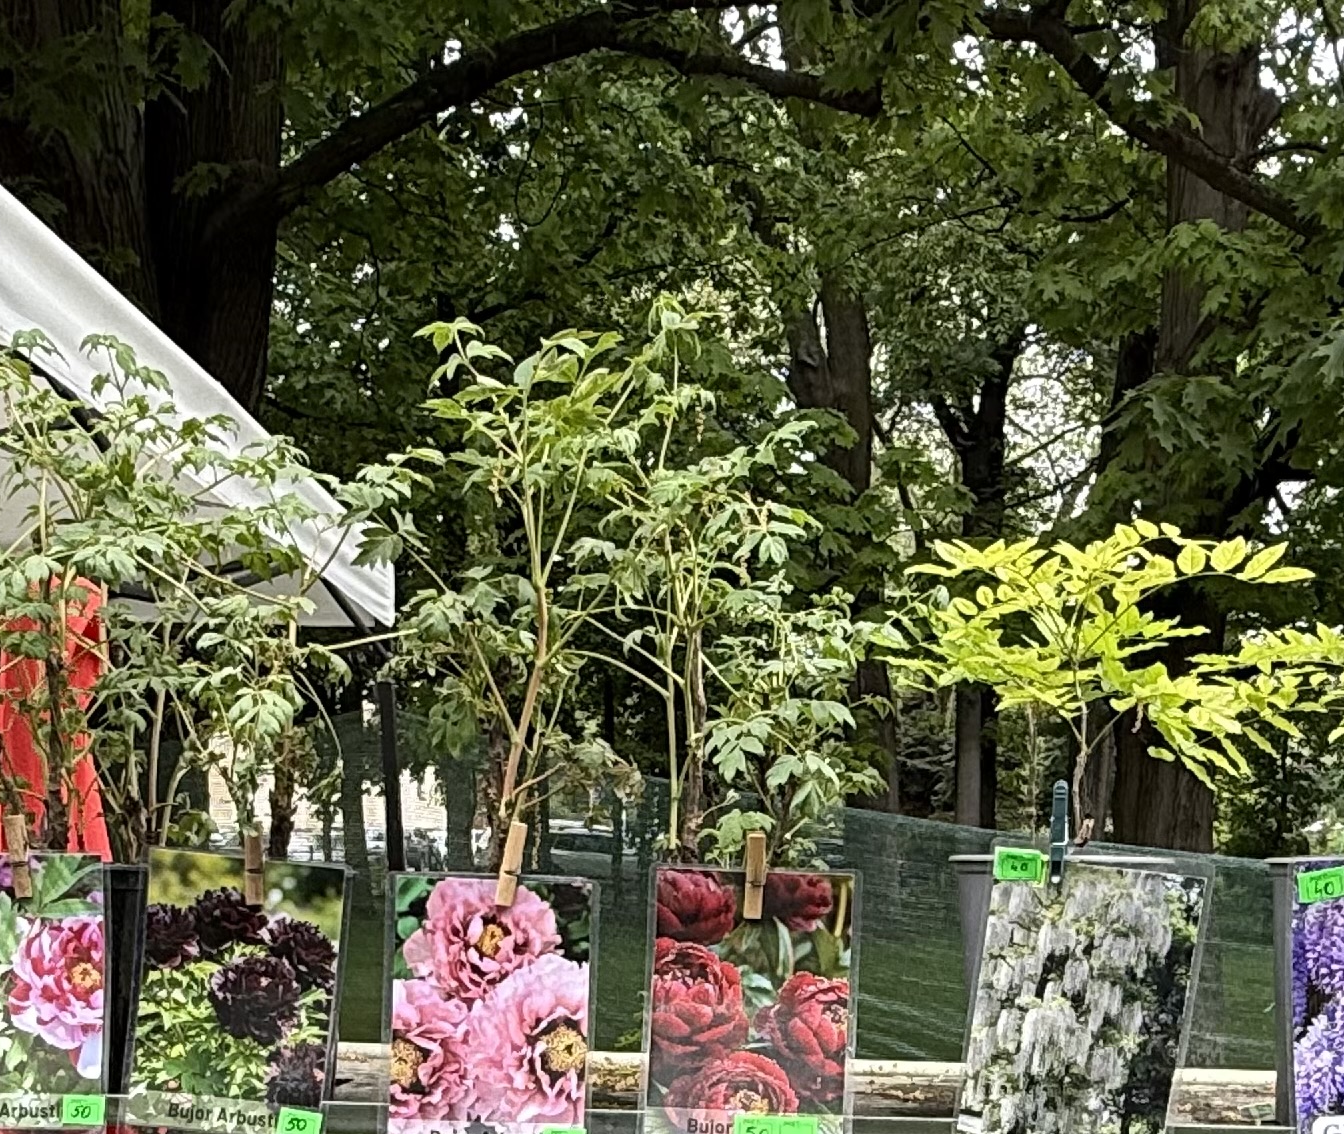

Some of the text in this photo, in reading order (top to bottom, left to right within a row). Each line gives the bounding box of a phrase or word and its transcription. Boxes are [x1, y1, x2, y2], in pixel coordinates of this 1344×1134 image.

[1315, 881, 1335, 897] 40
[70, 1105, 91, 1119] 50
[167, 1103, 213, 1122] Bujor
[284, 1117, 308, 1132] 50
